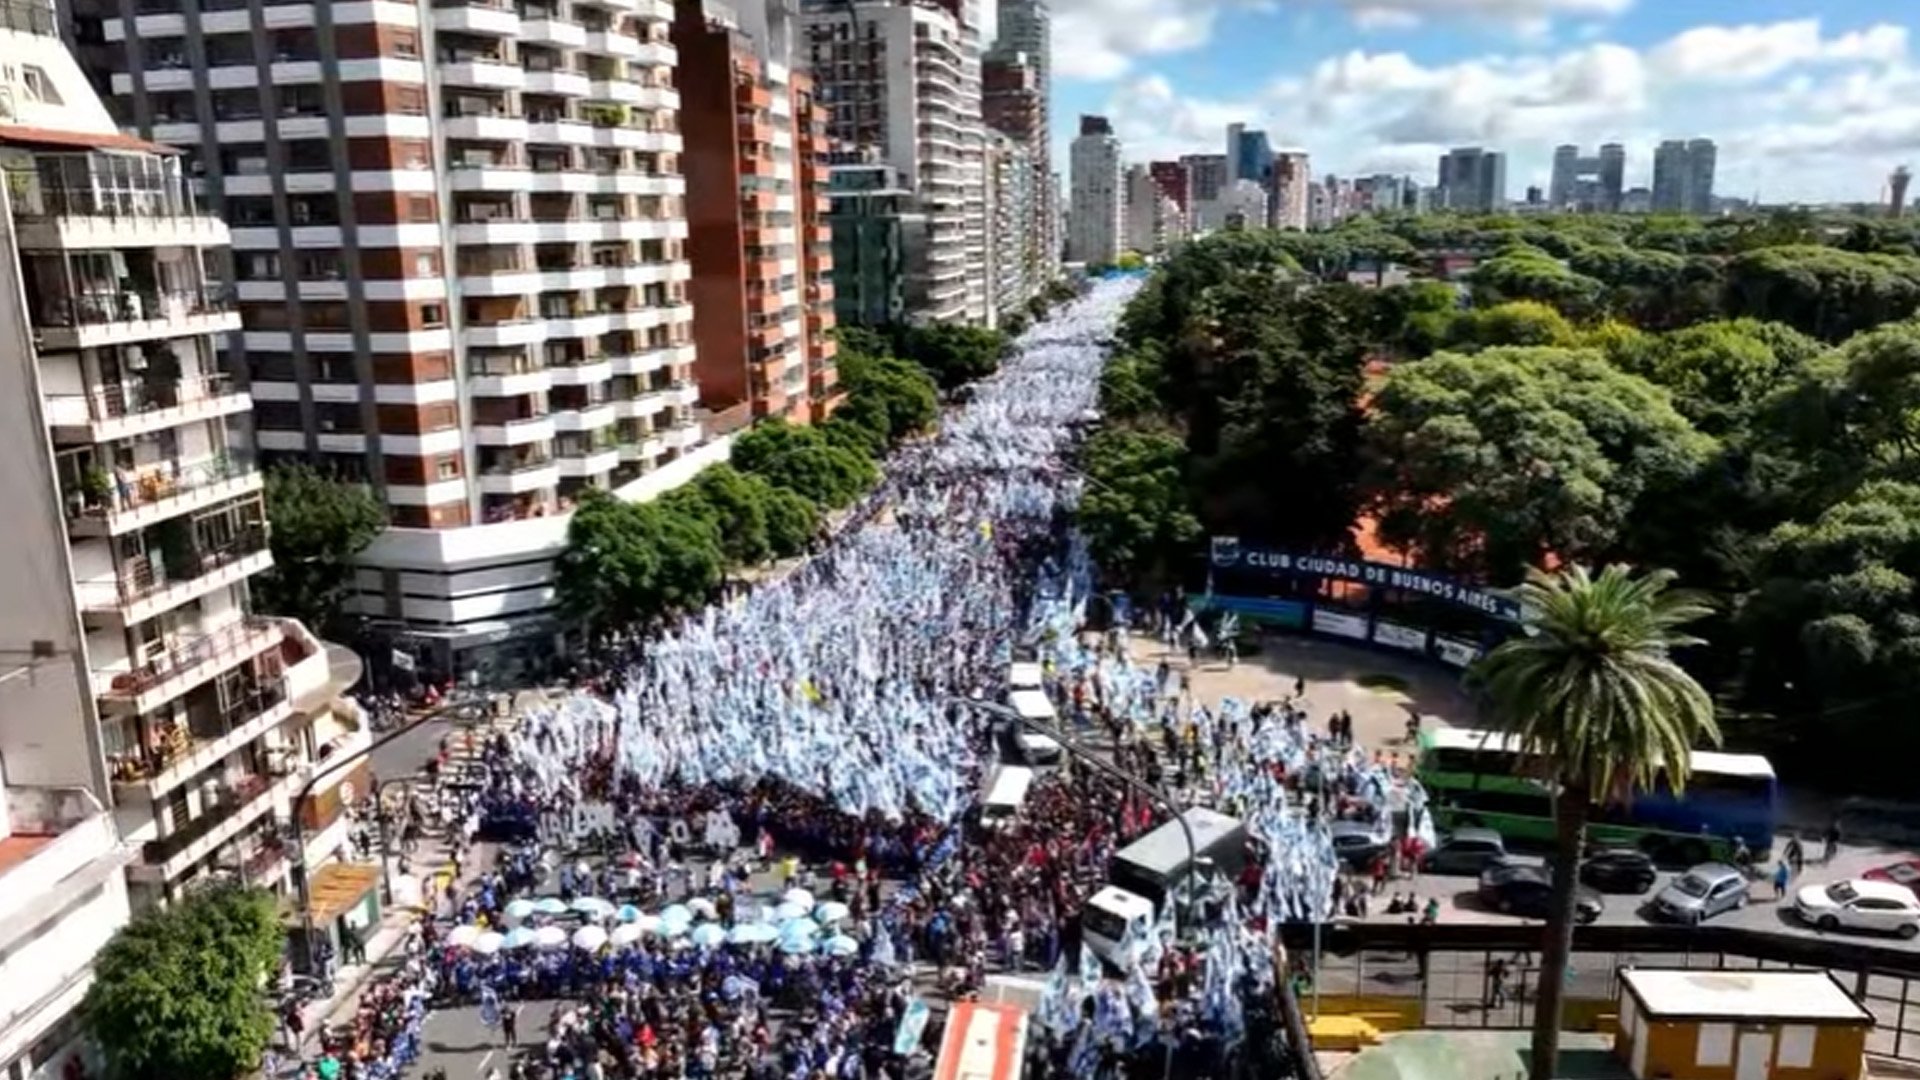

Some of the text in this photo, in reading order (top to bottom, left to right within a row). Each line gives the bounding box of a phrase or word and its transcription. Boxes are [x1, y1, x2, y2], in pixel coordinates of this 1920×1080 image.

[1246, 551, 1291, 568] CLUB
[1296, 557, 1360, 578] CIUDAD
[1365, 568, 1386, 583] DE
[1391, 568, 1454, 600] BUENOS
[1455, 587, 1500, 614] AIRES
